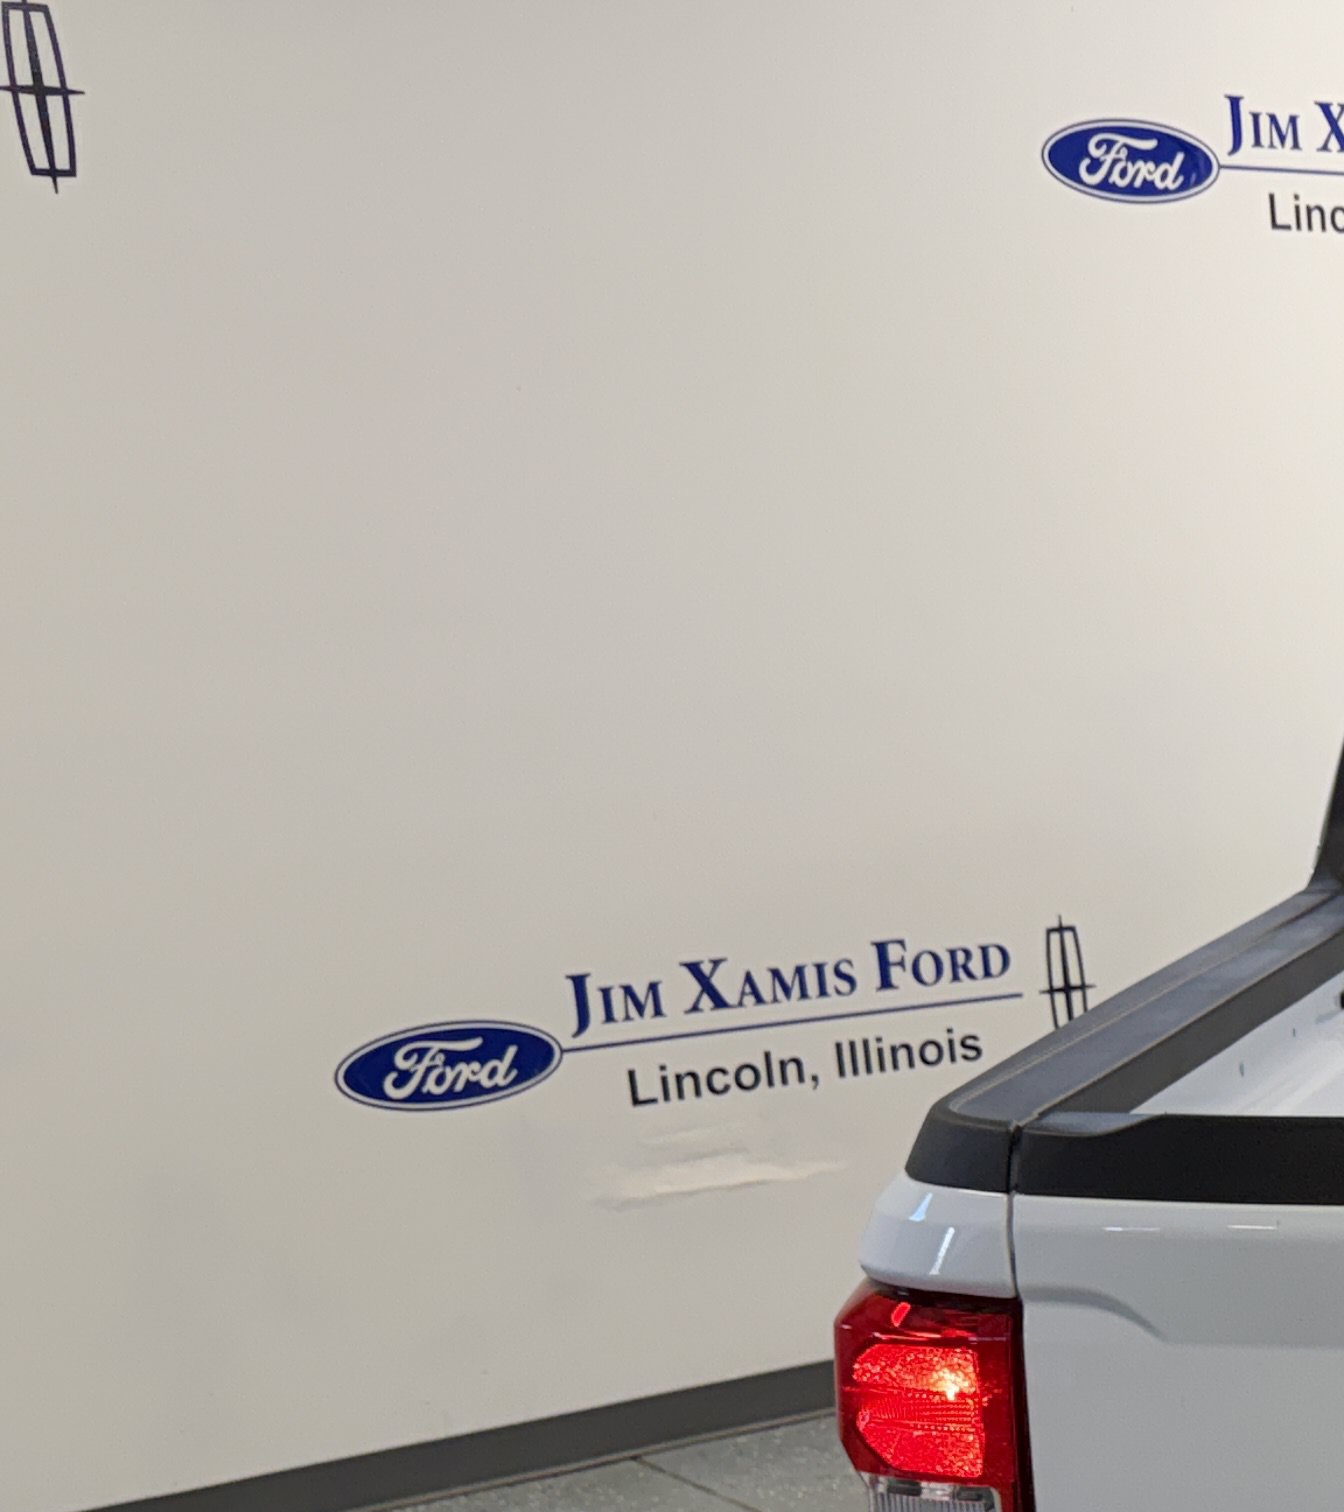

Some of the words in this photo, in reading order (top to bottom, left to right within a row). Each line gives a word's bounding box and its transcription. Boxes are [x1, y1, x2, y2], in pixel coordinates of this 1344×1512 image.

[1224, 94, 1302, 156] JIM
[1078, 132, 1183, 190] Ford
[565, 972, 666, 1038] JIM
[679, 956, 857, 1013] XAMIS
[870, 938, 1012, 991] FORD
[383, 1036, 518, 1099] Ford
[627, 1051, 820, 1106] Lincoln,
[835, 1028, 984, 1081] Illinois
